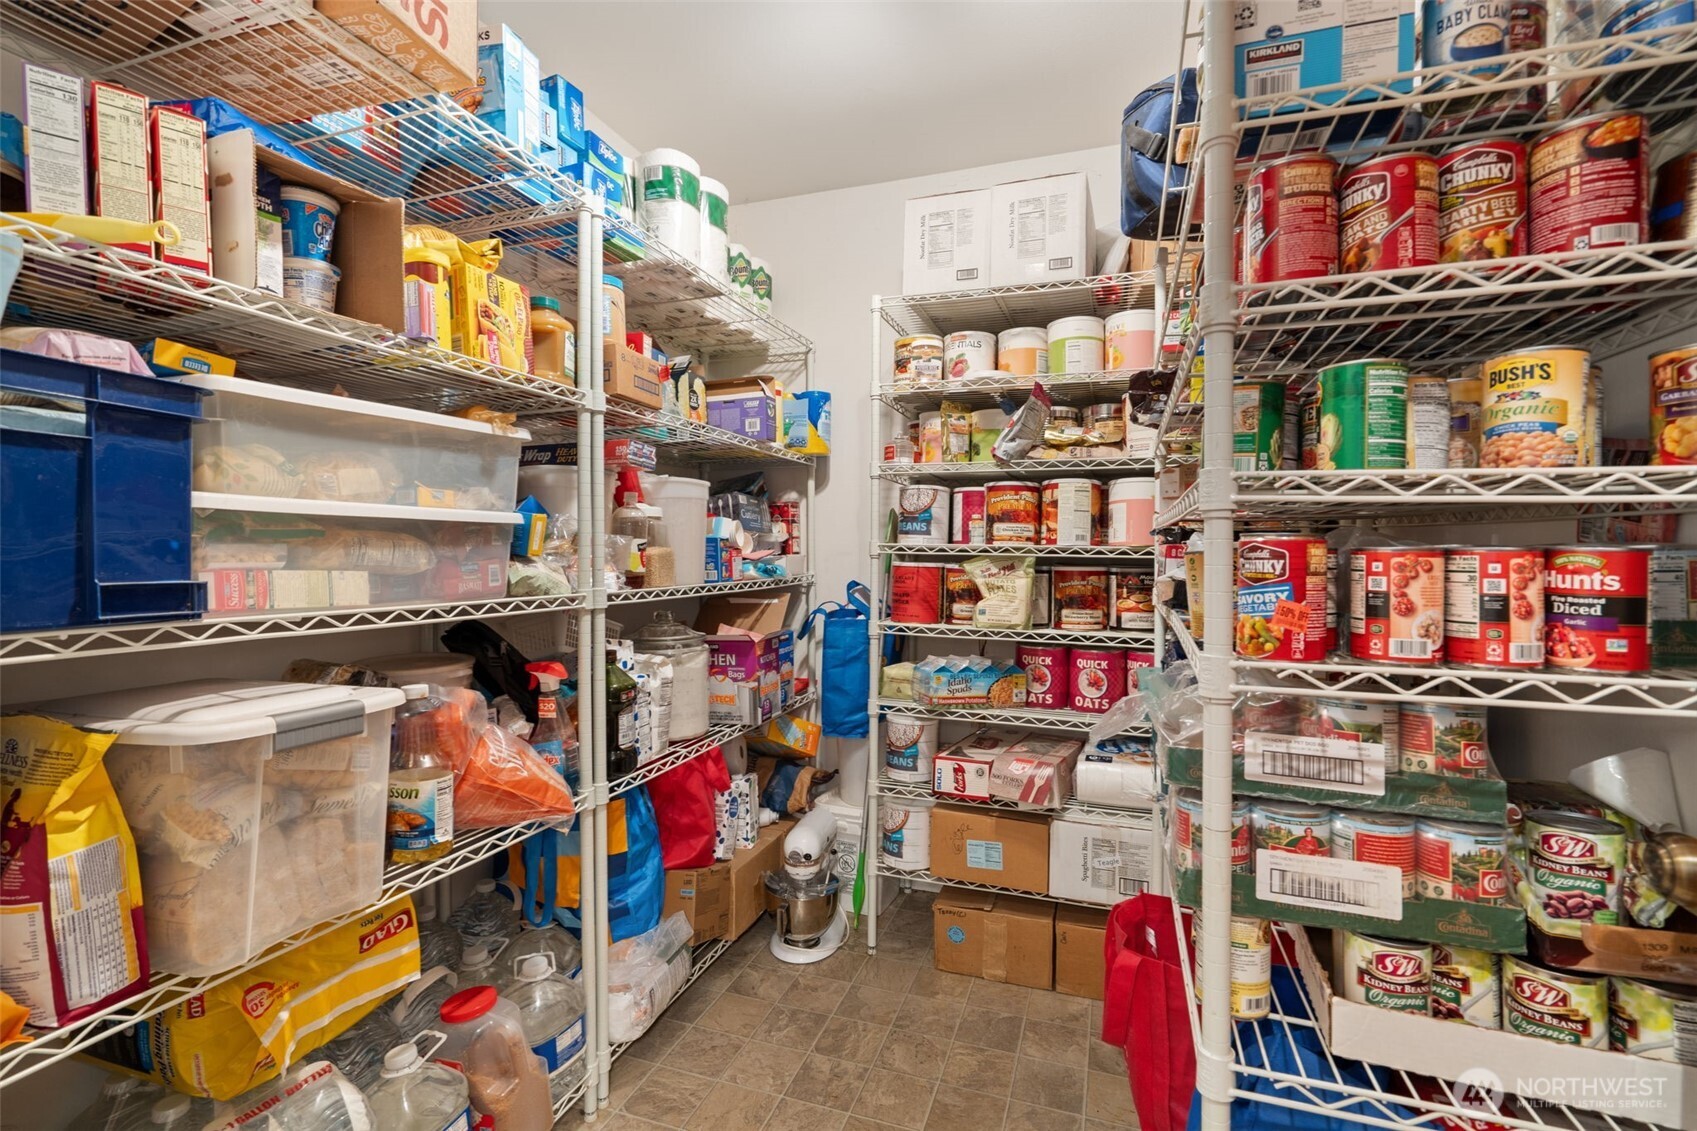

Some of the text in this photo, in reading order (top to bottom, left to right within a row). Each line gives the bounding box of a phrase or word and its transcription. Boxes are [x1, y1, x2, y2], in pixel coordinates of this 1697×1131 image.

[1436, 10, 1472, 35] BABY
[1513, 25, 1535, 36] Beef
[1249, 42, 1301, 59] KIRKLAND
[600, 140, 618, 164] Ziploc
[1441, 163, 1512, 192] CHUNKY
[1491, 196, 1517, 209] BEEF
[1363, 211, 1388, 228] AND
[1489, 363, 1552, 389] BUSH'S
[1484, 400, 1560, 422] Organic
[523, 449, 551, 463] Wrap
[740, 509, 761, 522] Cutlery
[1240, 558, 1285, 575] CHUNKY
[1569, 554, 1601, 566] NATURAL
[1544, 569, 1622, 591] Hunt's
[229, 572, 241, 607] Success
[1551, 595, 1606, 604] Fire Roasted
[1281, 606, 1297, 619] 50%
[1552, 603, 1603, 616] Diced
[1563, 618, 1587, 626] Garlic
[1022, 654, 1053, 666] QUICK
[1076, 658, 1108, 670] QUICK
[727, 671, 746, 679] Bags
[947, 676, 973, 688] Idaho
[946, 684, 973, 696] Spuds
[1025, 693, 1053, 704] ATS
[1075, 697, 1109, 710] OATS
[389, 786, 419, 801] sson
[1419, 792, 1468, 809] Contadina
[1542, 833, 1591, 859] S&W
[1081, 855, 1089, 882] Spaghetti
[1096, 858, 1120, 867] Teagle
[1531, 855, 1608, 879] KIDNEY BEANS
[1536, 868, 1602, 889] Organic
[362, 913, 411, 951] GLAD
[1437, 920, 1489, 938] Contadina
[1377, 955, 1419, 977] S&W
[1363, 974, 1430, 994] KIDNEY BEANS
[1368, 988, 1426, 1008] Organic
[1516, 979, 1564, 1007] S&W
[1510, 1011, 1575, 1043] Organic
[1543, 1013, 1584, 1031] BEANS
[152, 1011, 166, 1058] raining
